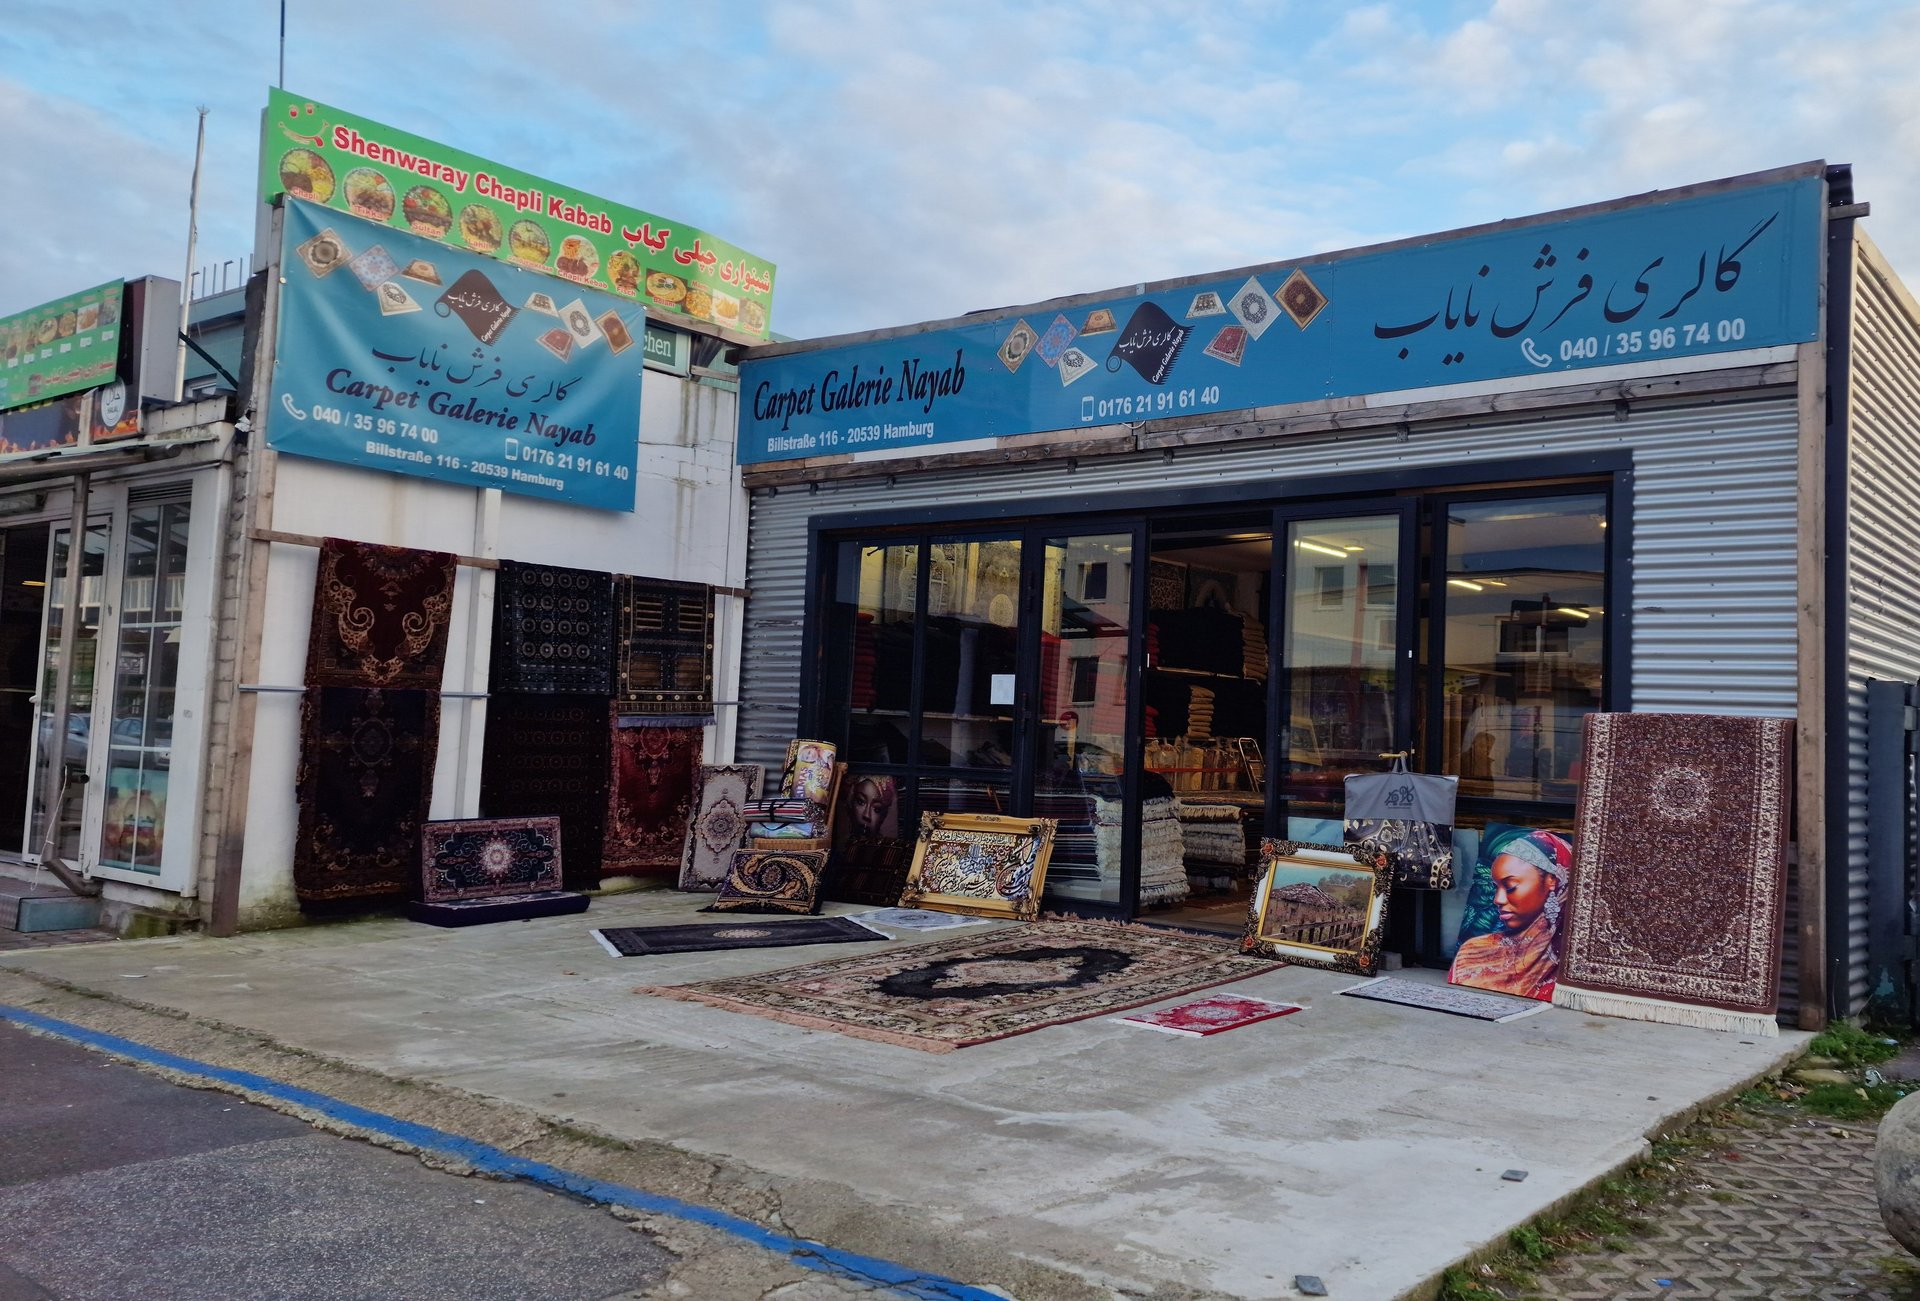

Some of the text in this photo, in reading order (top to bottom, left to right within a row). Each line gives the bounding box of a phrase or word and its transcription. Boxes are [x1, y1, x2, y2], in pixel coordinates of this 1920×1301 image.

[333, 125, 613, 234] Shenwaray Chapli Kabab
[412, 220, 442, 236] Sultan
[622, 223, 670, 254] کباب
[557, 269, 608, 289] Chapli Kebab
[616, 285, 636, 297] Fisch
[1490, 243, 1593, 338] فرش
[1374, 264, 1490, 365] نایاب
[1560, 317, 1746, 361] 040 / 35 96 74 00
[372, 344, 448, 386] نایاب
[446, 347, 502, 387] فرش
[325, 367, 596, 447] Carpet Galerie Nayab
[753, 348, 965, 431] Carpet Galerie Nayab
[1098, 385, 1220, 418] 0176 21 91 61 40
[312, 404, 341, 425] 040
[353, 413, 373, 431] 35
[377, 418, 396, 436] 96
[400, 422, 418, 440] 74
[421, 427, 438, 444] 00
[767, 432, 816, 452] Billstraße
[818, 429, 838, 446] 116
[847, 425, 881, 444] 20539
[883, 421, 934, 439] Hamburg
[365, 440, 433, 465] Billstraße
[436, 454, 460, 470] 116
[470, 460, 508, 478] 20539
[511, 468, 565, 491] Hamburg
[522, 446, 629, 481] 0176 21 91 61 40
